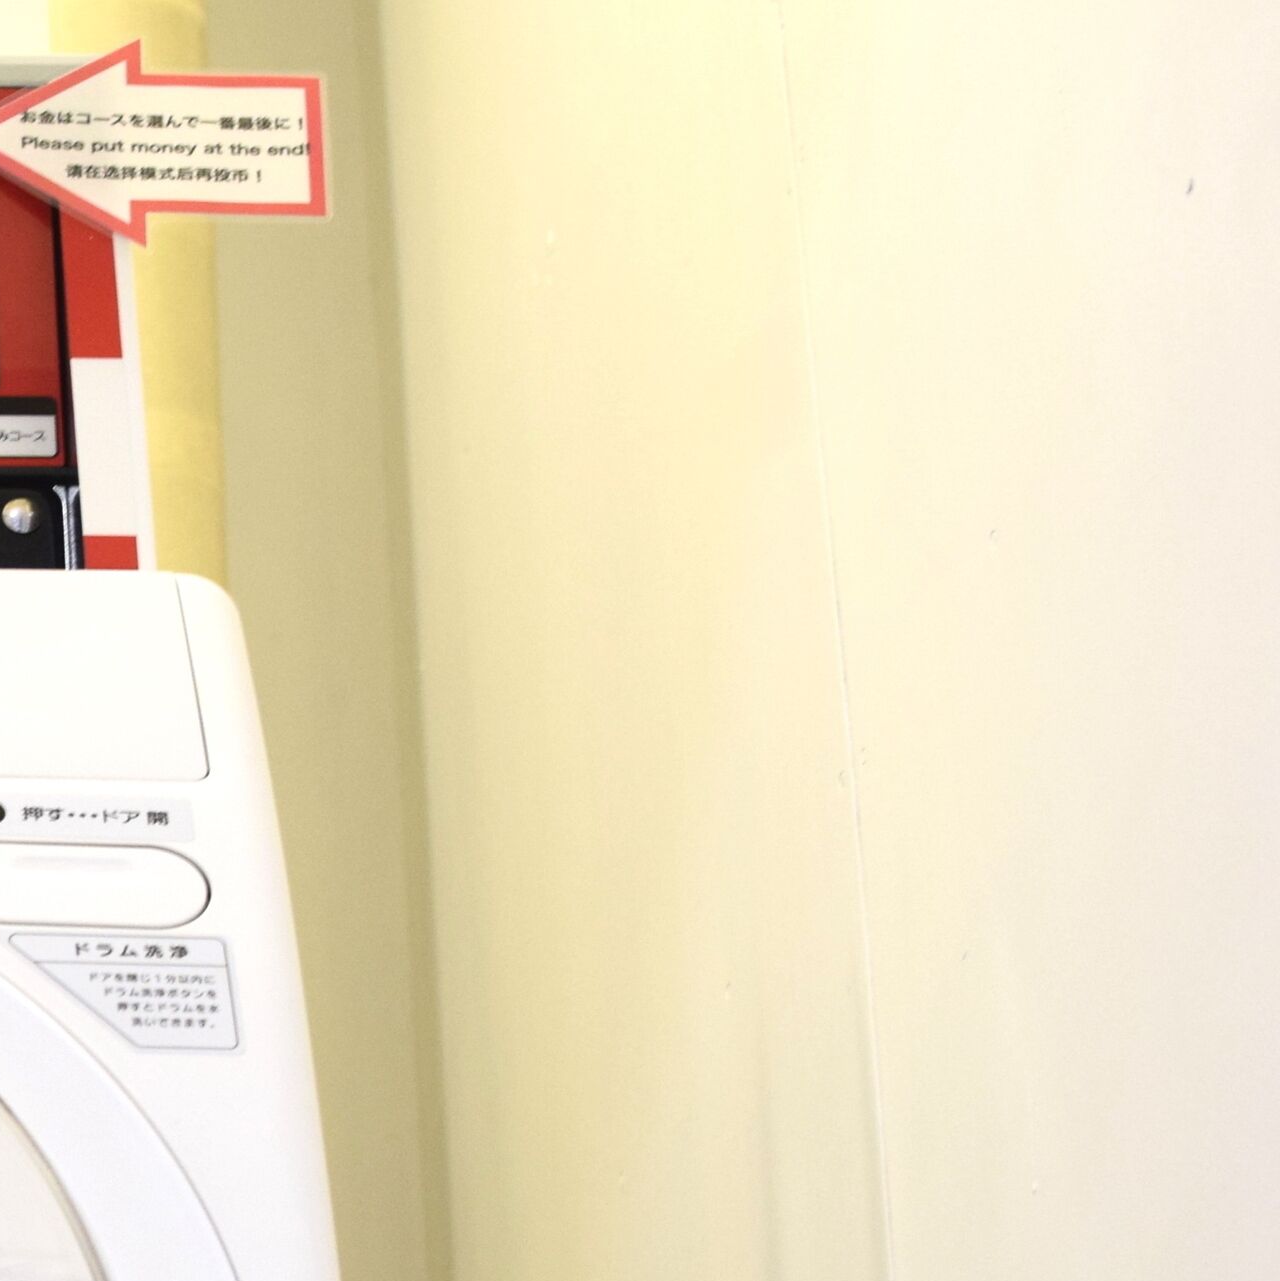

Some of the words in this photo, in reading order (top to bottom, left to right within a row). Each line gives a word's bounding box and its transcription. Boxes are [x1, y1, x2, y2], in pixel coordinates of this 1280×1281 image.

[20, 135, 85, 151] Please
[90, 139, 124, 153] put
[130, 143, 196, 156] money
[203, 142, 223, 156] at
[229, 143, 260, 156] the
